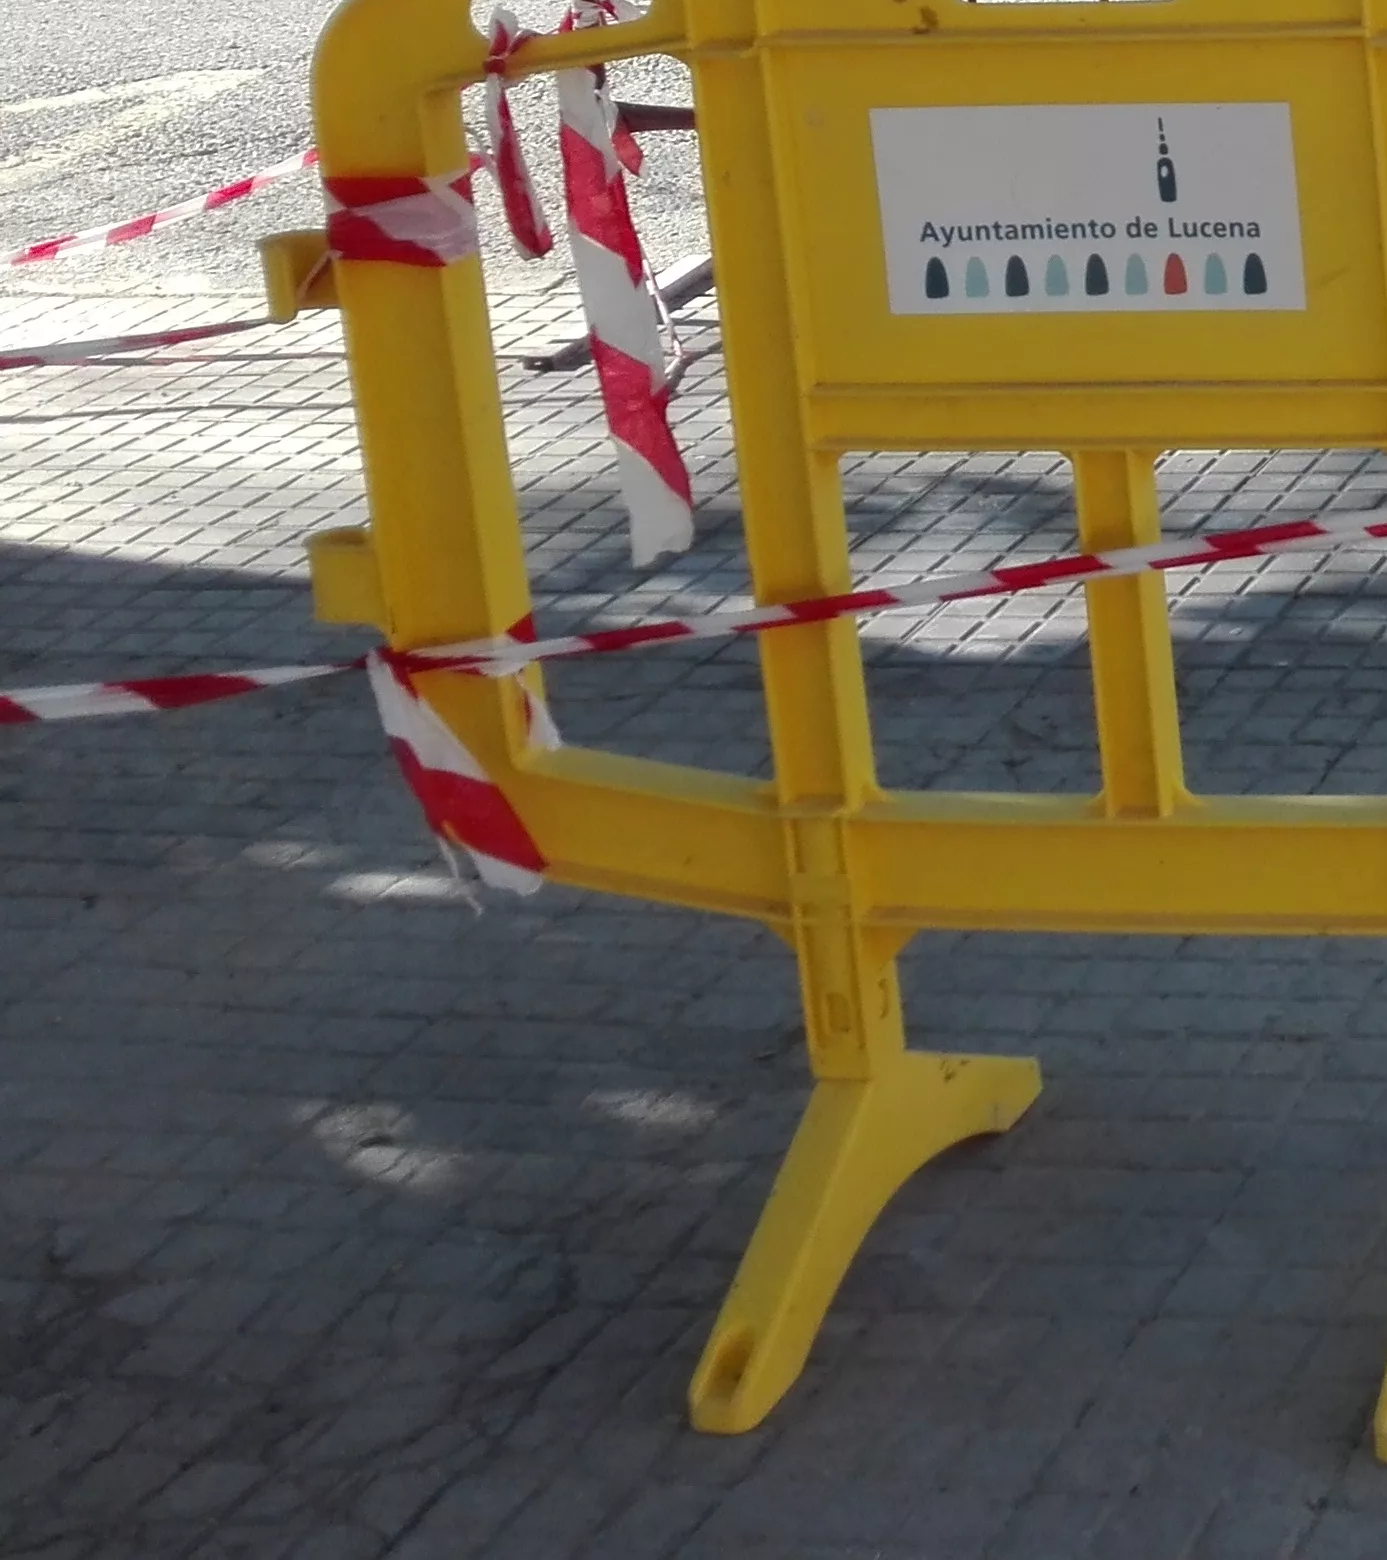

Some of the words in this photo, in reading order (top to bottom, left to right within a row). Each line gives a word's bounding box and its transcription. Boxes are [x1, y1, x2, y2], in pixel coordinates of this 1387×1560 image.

[919, 216, 1117, 248] Ayuntamiento
[1125, 215, 1160, 239] de
[1168, 216, 1262, 239] Lucena
